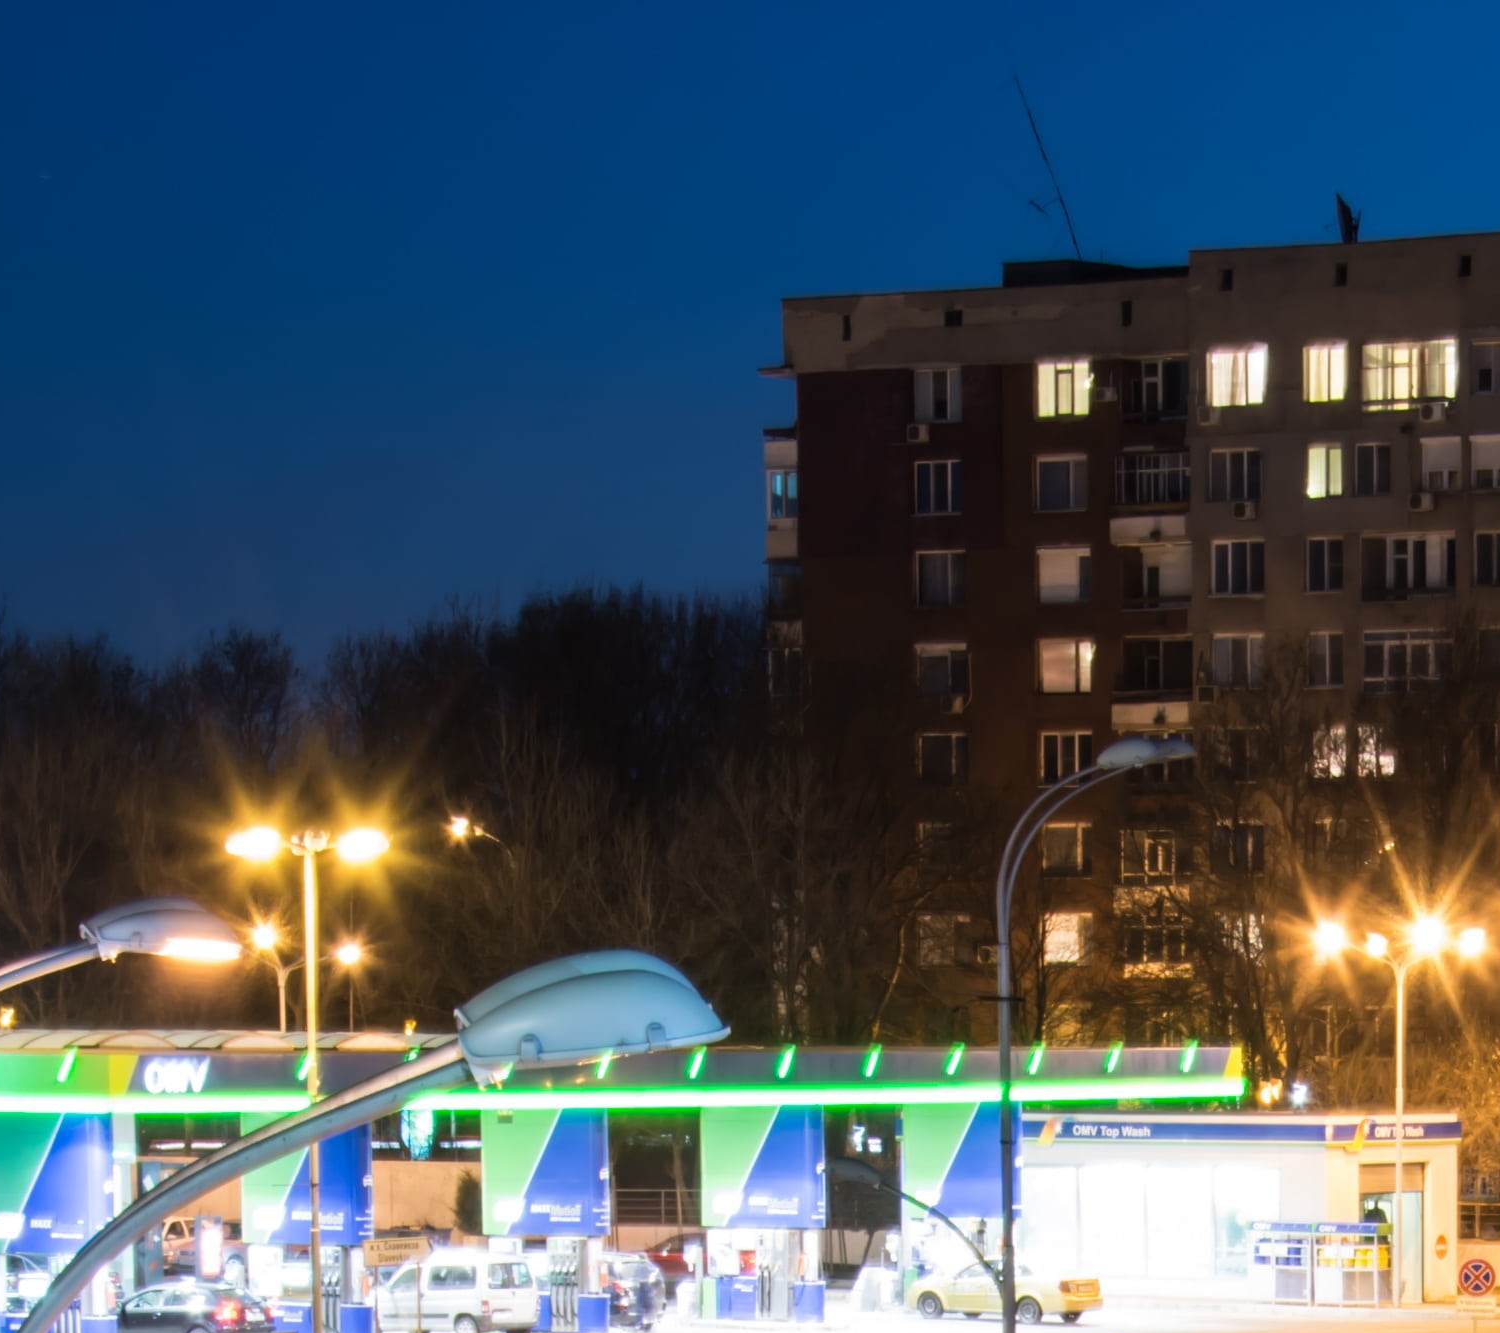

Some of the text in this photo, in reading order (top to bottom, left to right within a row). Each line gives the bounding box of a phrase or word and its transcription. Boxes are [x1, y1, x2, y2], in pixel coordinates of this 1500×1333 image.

[144, 1057, 211, 1094] OMV
[1072, 1124, 1151, 1139] OMV Top Wash
